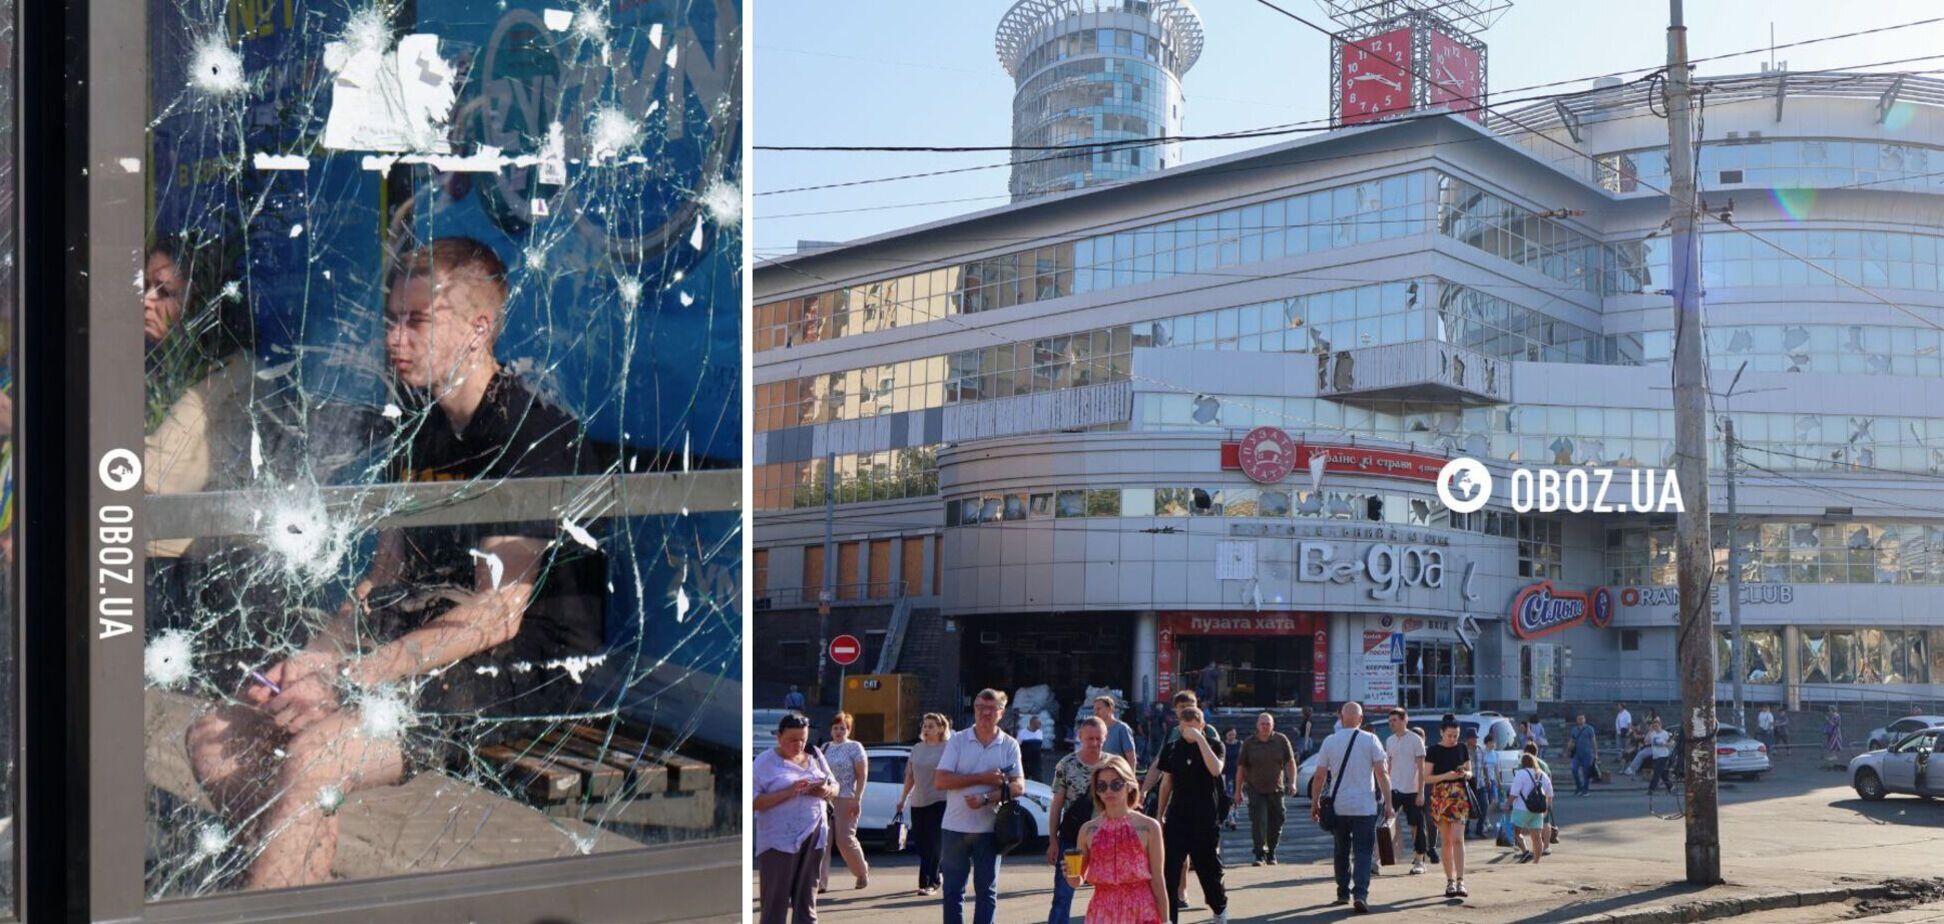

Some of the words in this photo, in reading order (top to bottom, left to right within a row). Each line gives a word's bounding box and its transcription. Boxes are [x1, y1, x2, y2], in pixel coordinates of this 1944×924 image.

[1371, 40, 1382, 52] 12
[1348, 63, 1358, 73] 10
[1347, 79, 1354, 89] 9
